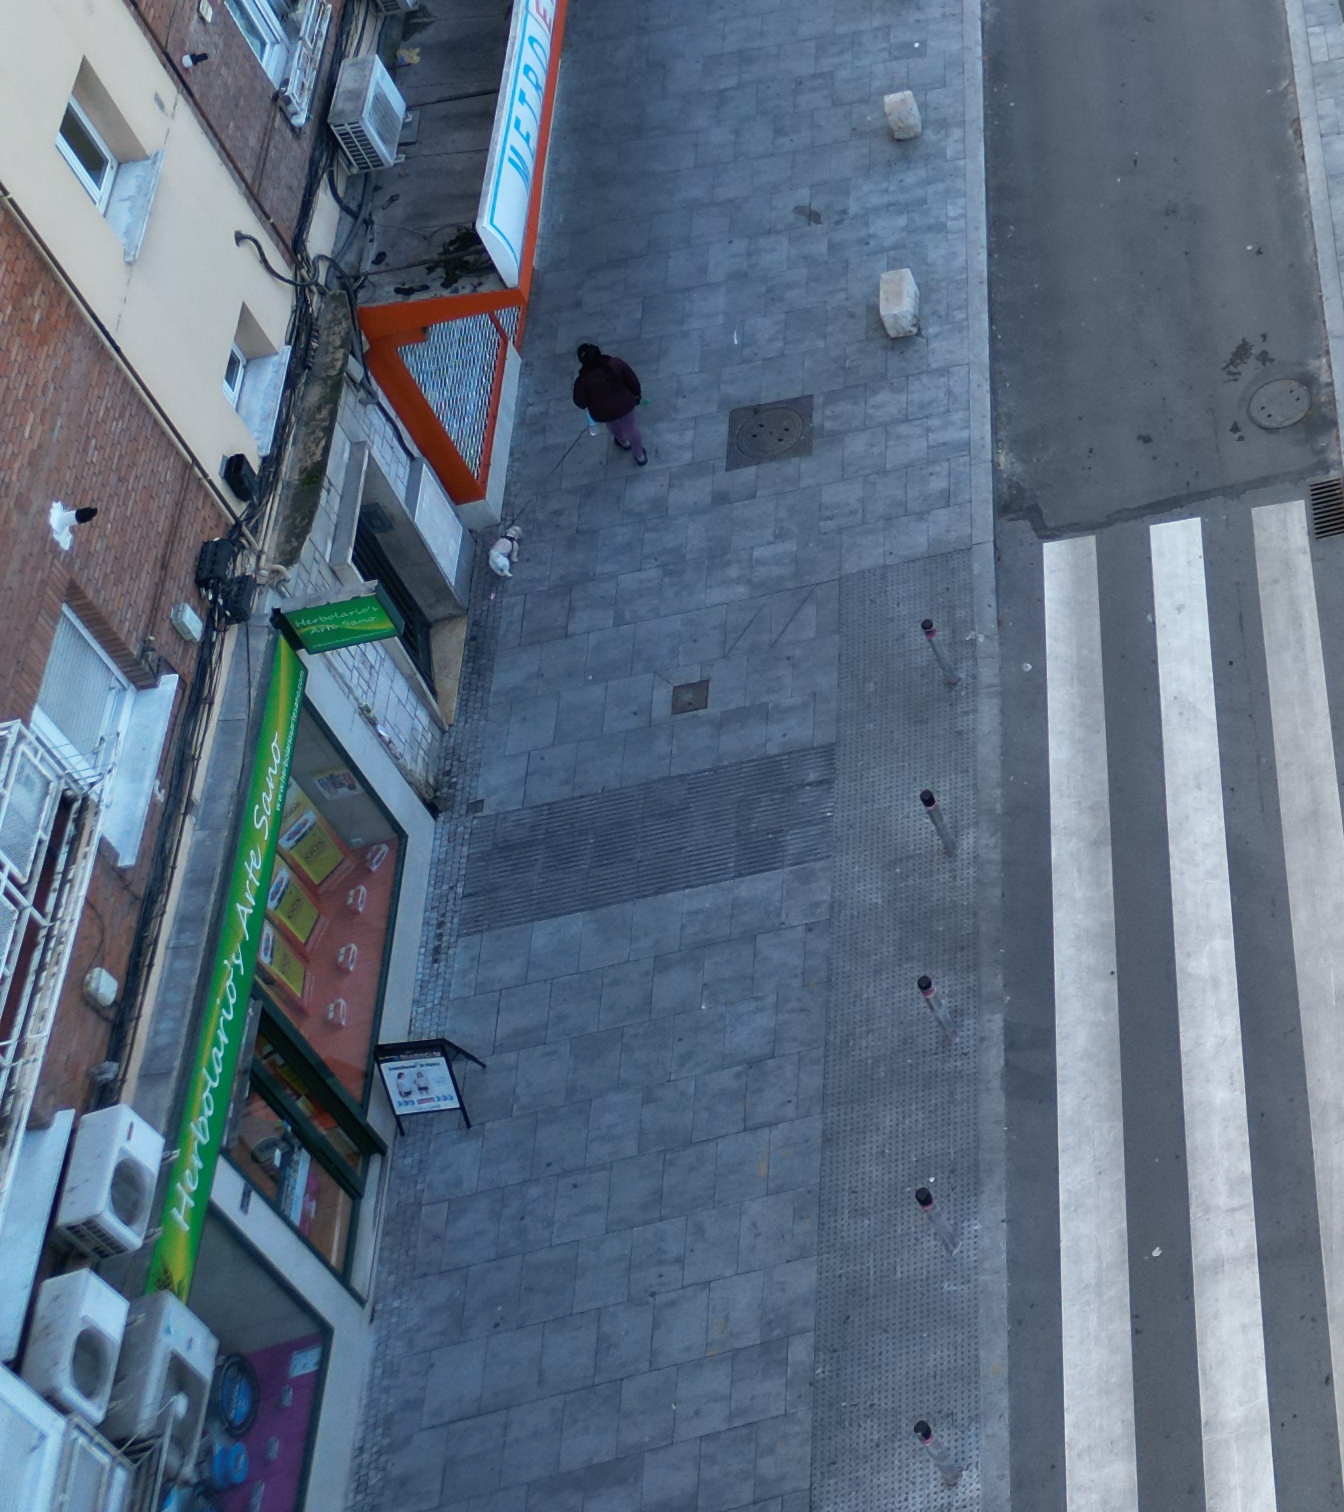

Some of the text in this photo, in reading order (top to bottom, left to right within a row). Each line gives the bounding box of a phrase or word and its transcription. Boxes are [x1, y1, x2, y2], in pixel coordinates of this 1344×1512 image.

[507, 35, 548, 194] METRO
[170, 731, 282, 1232] Herbolario's Arte Sano
